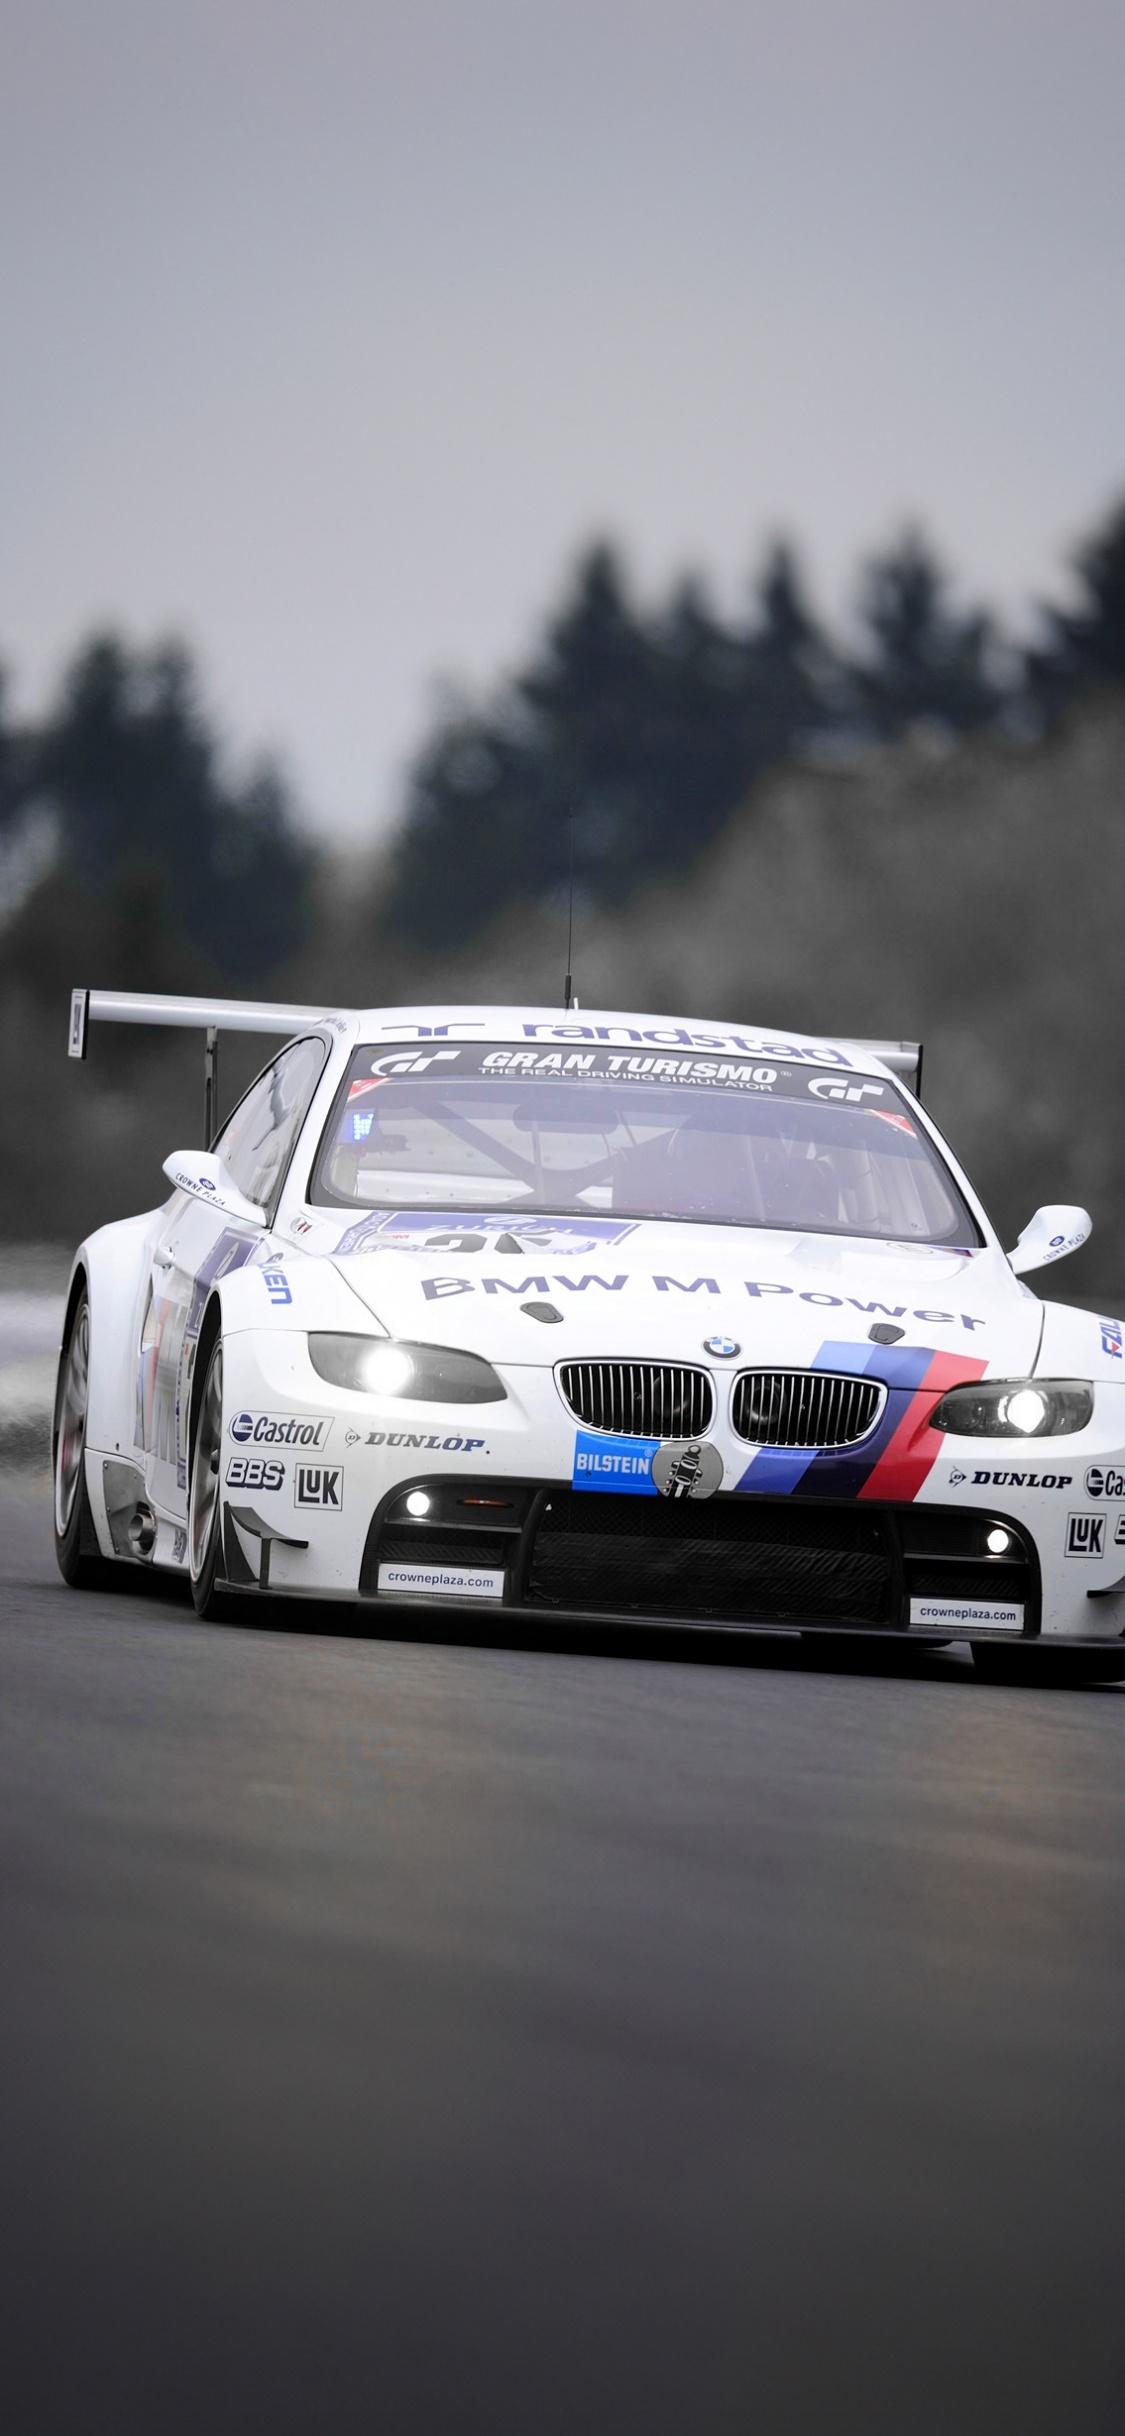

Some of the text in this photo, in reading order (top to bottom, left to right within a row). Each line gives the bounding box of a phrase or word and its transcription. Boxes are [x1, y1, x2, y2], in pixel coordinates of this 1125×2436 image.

[521, 1023, 855, 1068] randstad
[477, 1067, 773, 1092] THE REAL DRIVING SIMULATOR
[482, 1051, 778, 1084] GRAN TURISMO
[175, 1172, 226, 1206] CROWNE PLAZA
[258, 1262, 293, 1305] KEN
[420, 1275, 987, 1332] BMW M Power
[253, 1414, 325, 1446] Castrol
[364, 1431, 486, 1452] DUNLOP
[225, 1457, 286, 1491] BBS
[576, 1453, 650, 1475] BILSTEIN
[971, 1470, 1073, 1489] DUNLOP
[1105, 1470, 1125, 1496] Ca
[387, 1570, 495, 1588] crowneplaza.com
[920, 1606, 1017, 1621] crowneplaza.com
